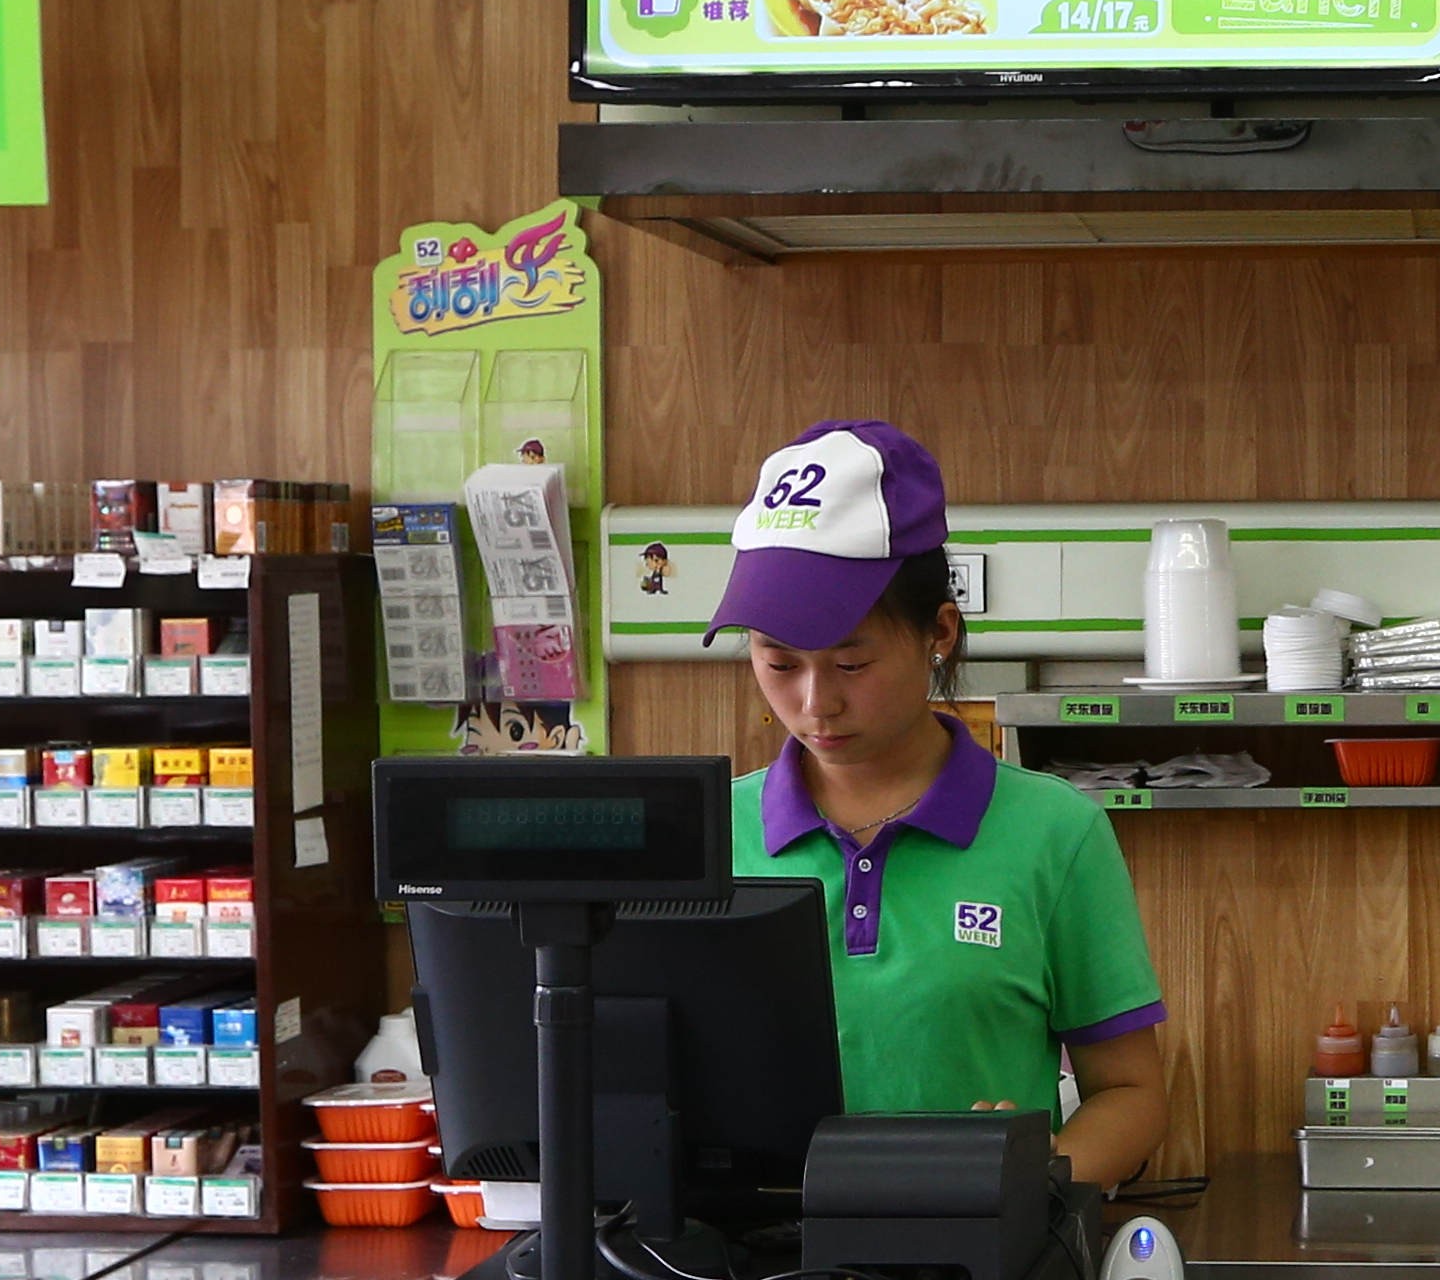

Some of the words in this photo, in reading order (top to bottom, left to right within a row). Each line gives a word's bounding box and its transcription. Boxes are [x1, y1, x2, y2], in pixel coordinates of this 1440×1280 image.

[1058, 0, 1150, 33] 14/17元
[417, 240, 440, 259] 52
[762, 462, 827, 509] 52
[756, 509, 818, 531] WEEK
[957, 904, 999, 934] 52
[957, 930, 1000, 947] WEEK
